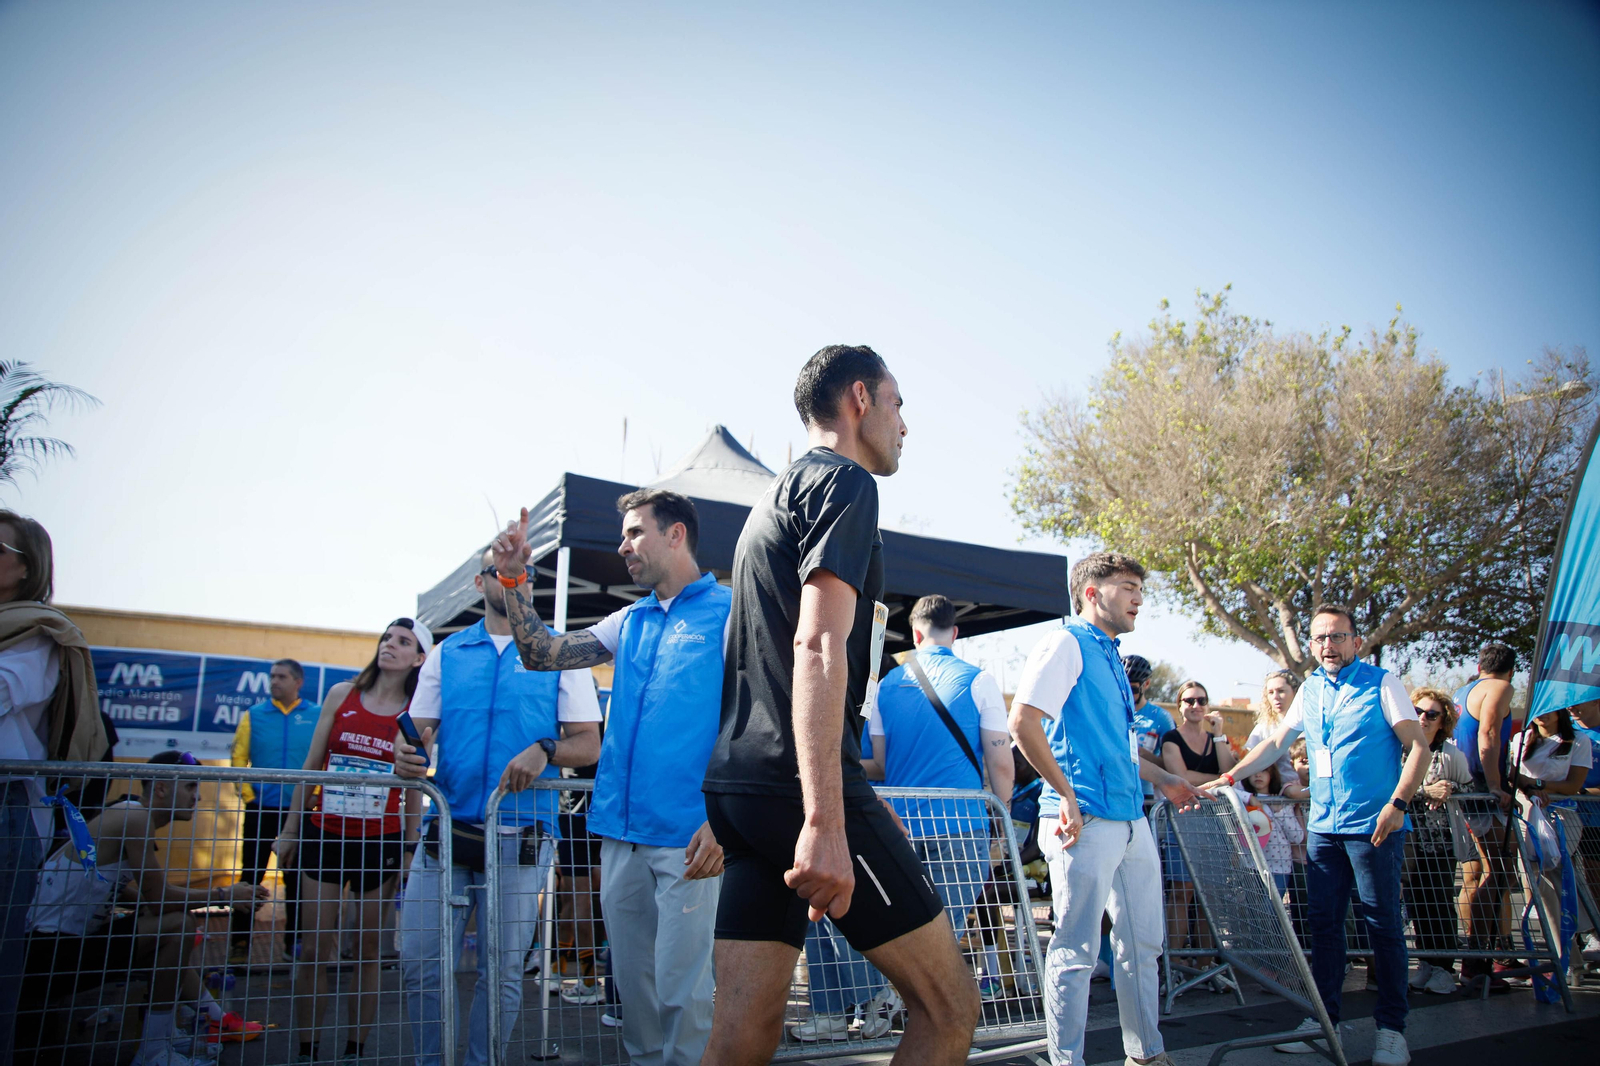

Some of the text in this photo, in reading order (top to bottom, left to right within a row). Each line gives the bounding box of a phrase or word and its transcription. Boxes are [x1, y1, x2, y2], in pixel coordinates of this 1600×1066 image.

[97, 687, 183, 701] edio Maratón
[214, 693, 252, 706] Medio
[102, 698, 181, 723] lmería
[339, 731, 372, 746] ATHLETIC
[347, 742, 384, 756] TARRAGONA
